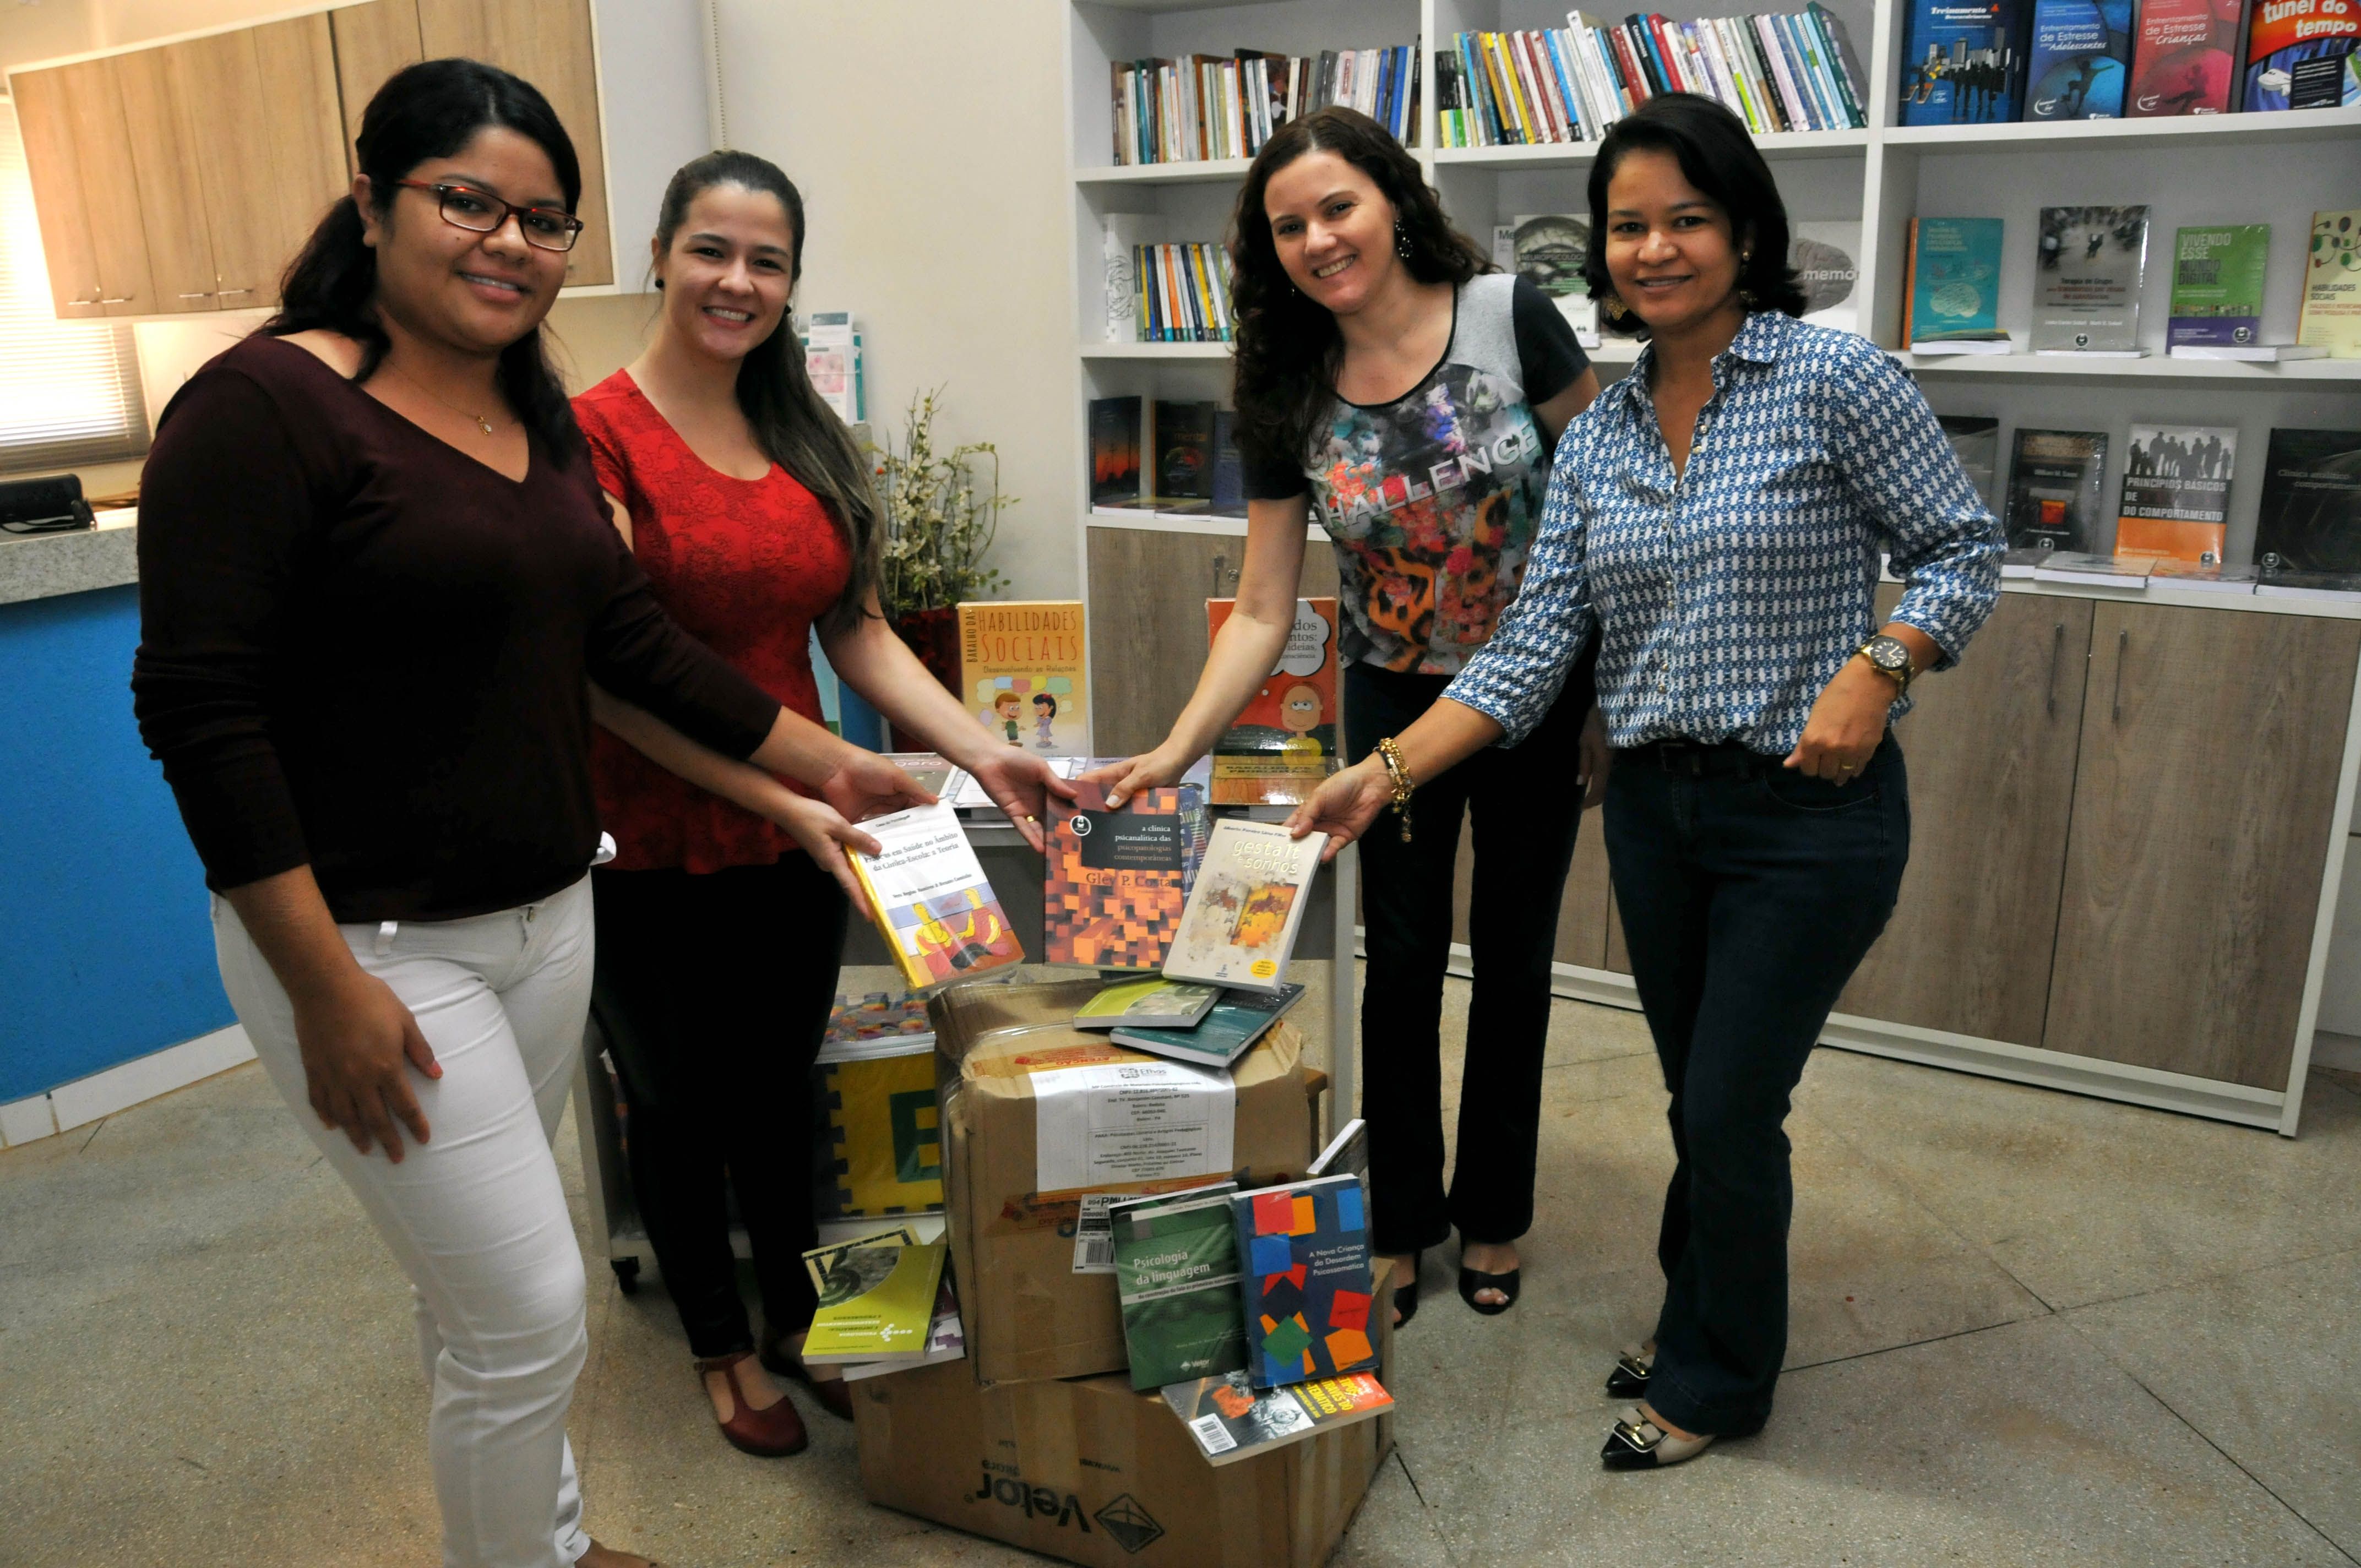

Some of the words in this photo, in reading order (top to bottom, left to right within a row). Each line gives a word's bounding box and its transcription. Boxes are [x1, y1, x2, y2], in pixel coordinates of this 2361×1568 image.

[2321, 0, 2348, 15] do
[2146, 14, 2208, 25] Enfrentamento
[2040, 22, 2101, 32] Enfrentamento
[2146, 26, 2161, 36] de
[2164, 22, 2206, 33] Estresse
[2295, 18, 2358, 38] tempo
[2040, 33, 2055, 42] de
[2057, 31, 2099, 41] Estresse
[2155, 32, 2207, 45] Crianças
[2049, 40, 2108, 51] Adolescentes
[2181, 233, 2232, 247] VIVENDO
[2182, 246, 2210, 259] ESSE
[2178, 272, 2218, 285] DIGITAL
[2312, 284, 2357, 292] HABILIDADES
[2310, 292, 2336, 301] SOCIAIS
[1313, 421, 1541, 531] HALLENGE
[2126, 476, 2182, 491] PRINCÍPIOS
[2125, 492, 2138, 502] DE
[2123, 505, 2137, 516] DO
[2139, 507, 2223, 521] COMPORTAMENTO
[978, 610, 1076, 631] HABILIDADES
[1288, 633, 1318, 641] ntos:
[966, 627, 978, 663] BARALHO
[982, 634, 1078, 662] SOCIAIS
[891, 847, 902, 857] em
[903, 840, 923, 853] Saúde
[924, 838, 934, 846] no
[934, 831, 959, 845] Âmbito
[1114, 834, 1157, 843] psicanalítica
[1117, 843, 1172, 852] psicopatologias
[1232, 840, 1302, 861] gestalt
[873, 863, 882, 872] da
[937, 842, 960, 855] Teoria
[1114, 853, 1172, 862] contemporâneas
[1244, 857, 1299, 875] sonhos
[1121, 874, 1131, 886] P.
[1134, 875, 1172, 887] Costa
[1140, 1068, 1167, 1076] Ethos
[889, 1088, 940, 1183] E
[1309, 1250, 1315, 1259] A
[1316, 1248, 1336, 1257] Nova
[1337, 1243, 1365, 1254] Criança
[1134, 1249, 1189, 1270] Psicologia
[1325, 1253, 1362, 1265] Desordem
[1135, 1272, 1151, 1287] da
[1151, 1262, 1211, 1284] linguagem
[1313, 1263, 1365, 1277] Psicossomática
[1337, 1399, 1354, 1411] DO
[976, 1472, 1092, 1534] Vetor
